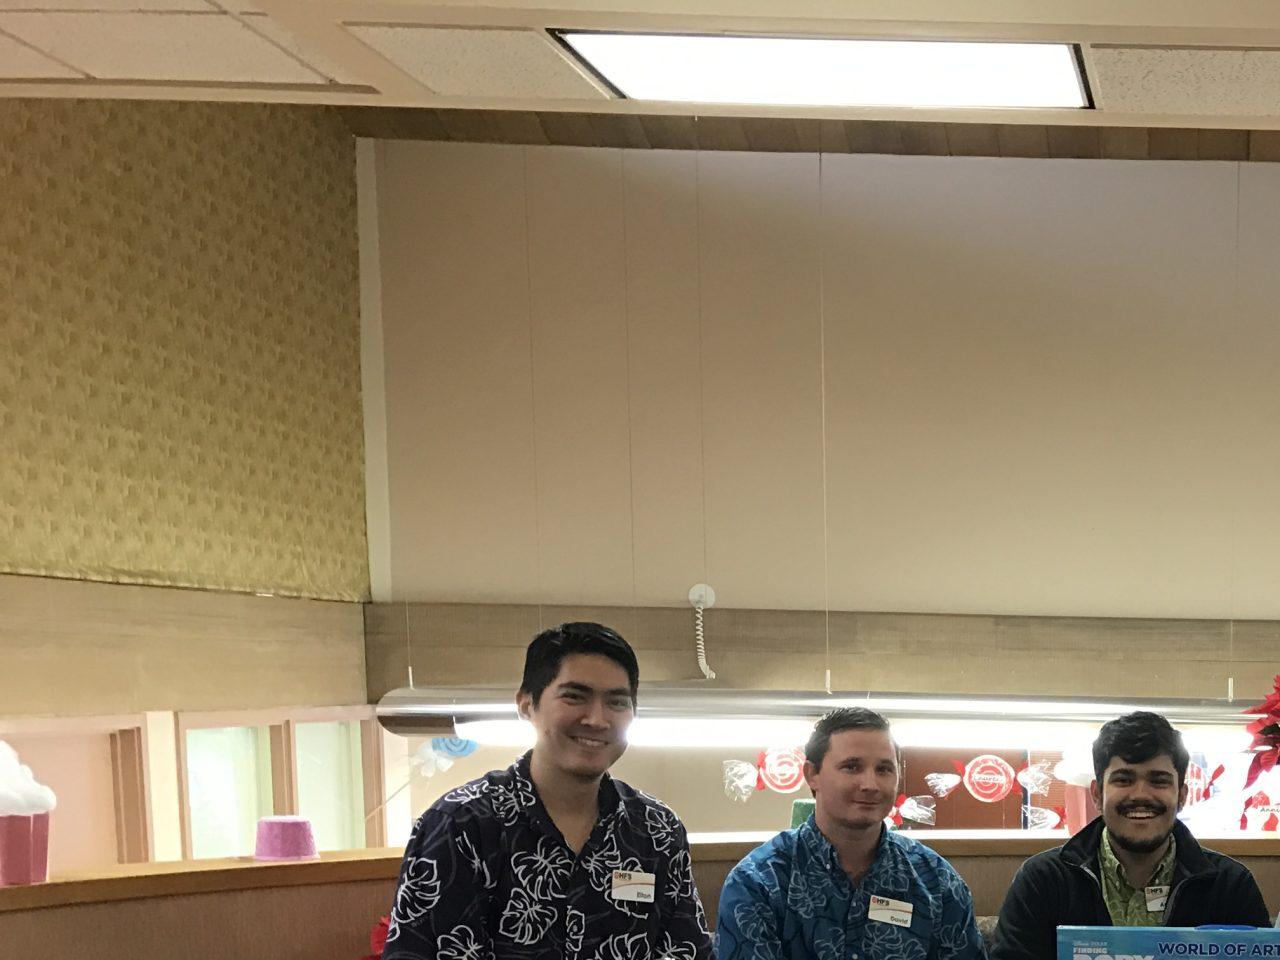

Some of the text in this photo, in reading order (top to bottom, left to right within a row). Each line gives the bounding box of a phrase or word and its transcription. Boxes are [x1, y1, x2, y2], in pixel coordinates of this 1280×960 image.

[890, 916, 909, 925] David
[1073, 946, 1108, 954] FINDING
[1157, 942, 1220, 956] WORLD
[1224, 943, 1247, 956] OF
